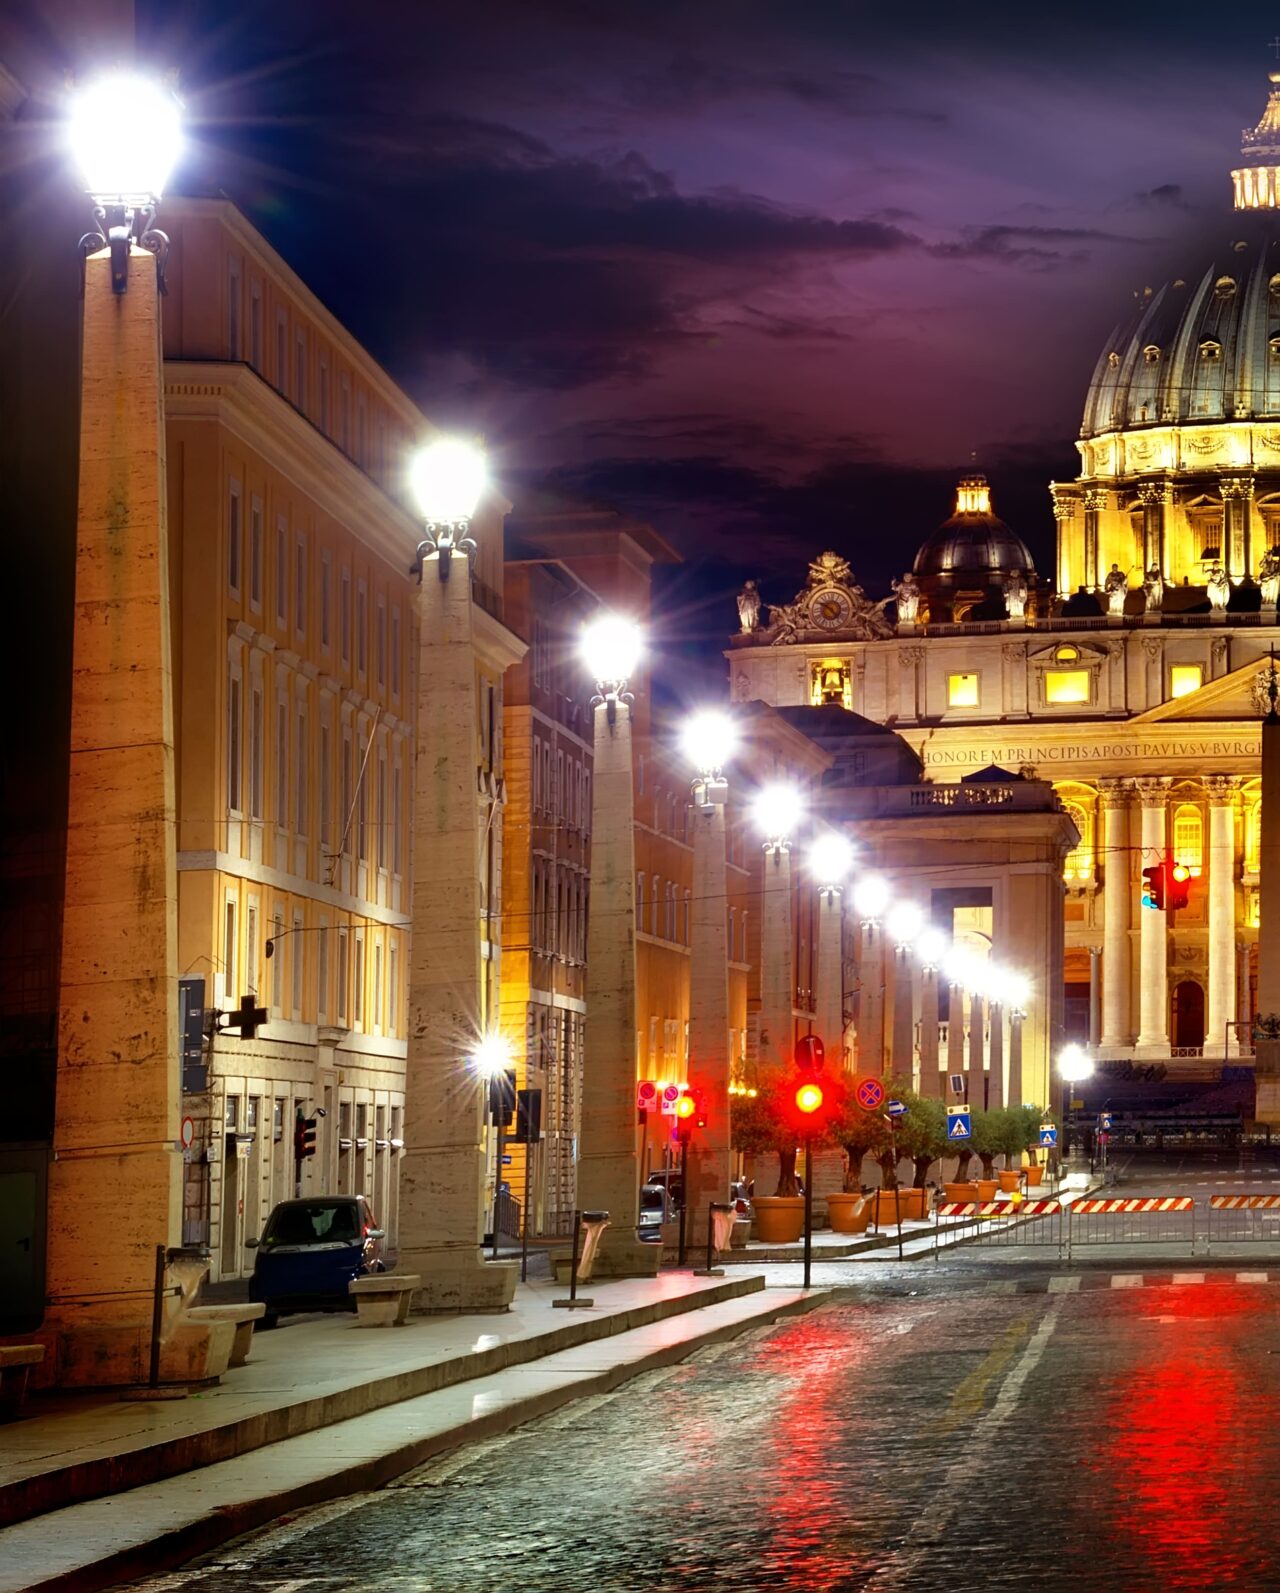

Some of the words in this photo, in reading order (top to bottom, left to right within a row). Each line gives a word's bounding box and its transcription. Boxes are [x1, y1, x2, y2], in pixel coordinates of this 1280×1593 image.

[1007, 745, 1089, 761] PRINCIPIS
[1092, 744, 1141, 758] APOST
[1143, 743, 1197, 756] PAVLVS
[1199, 743, 1209, 755] V
